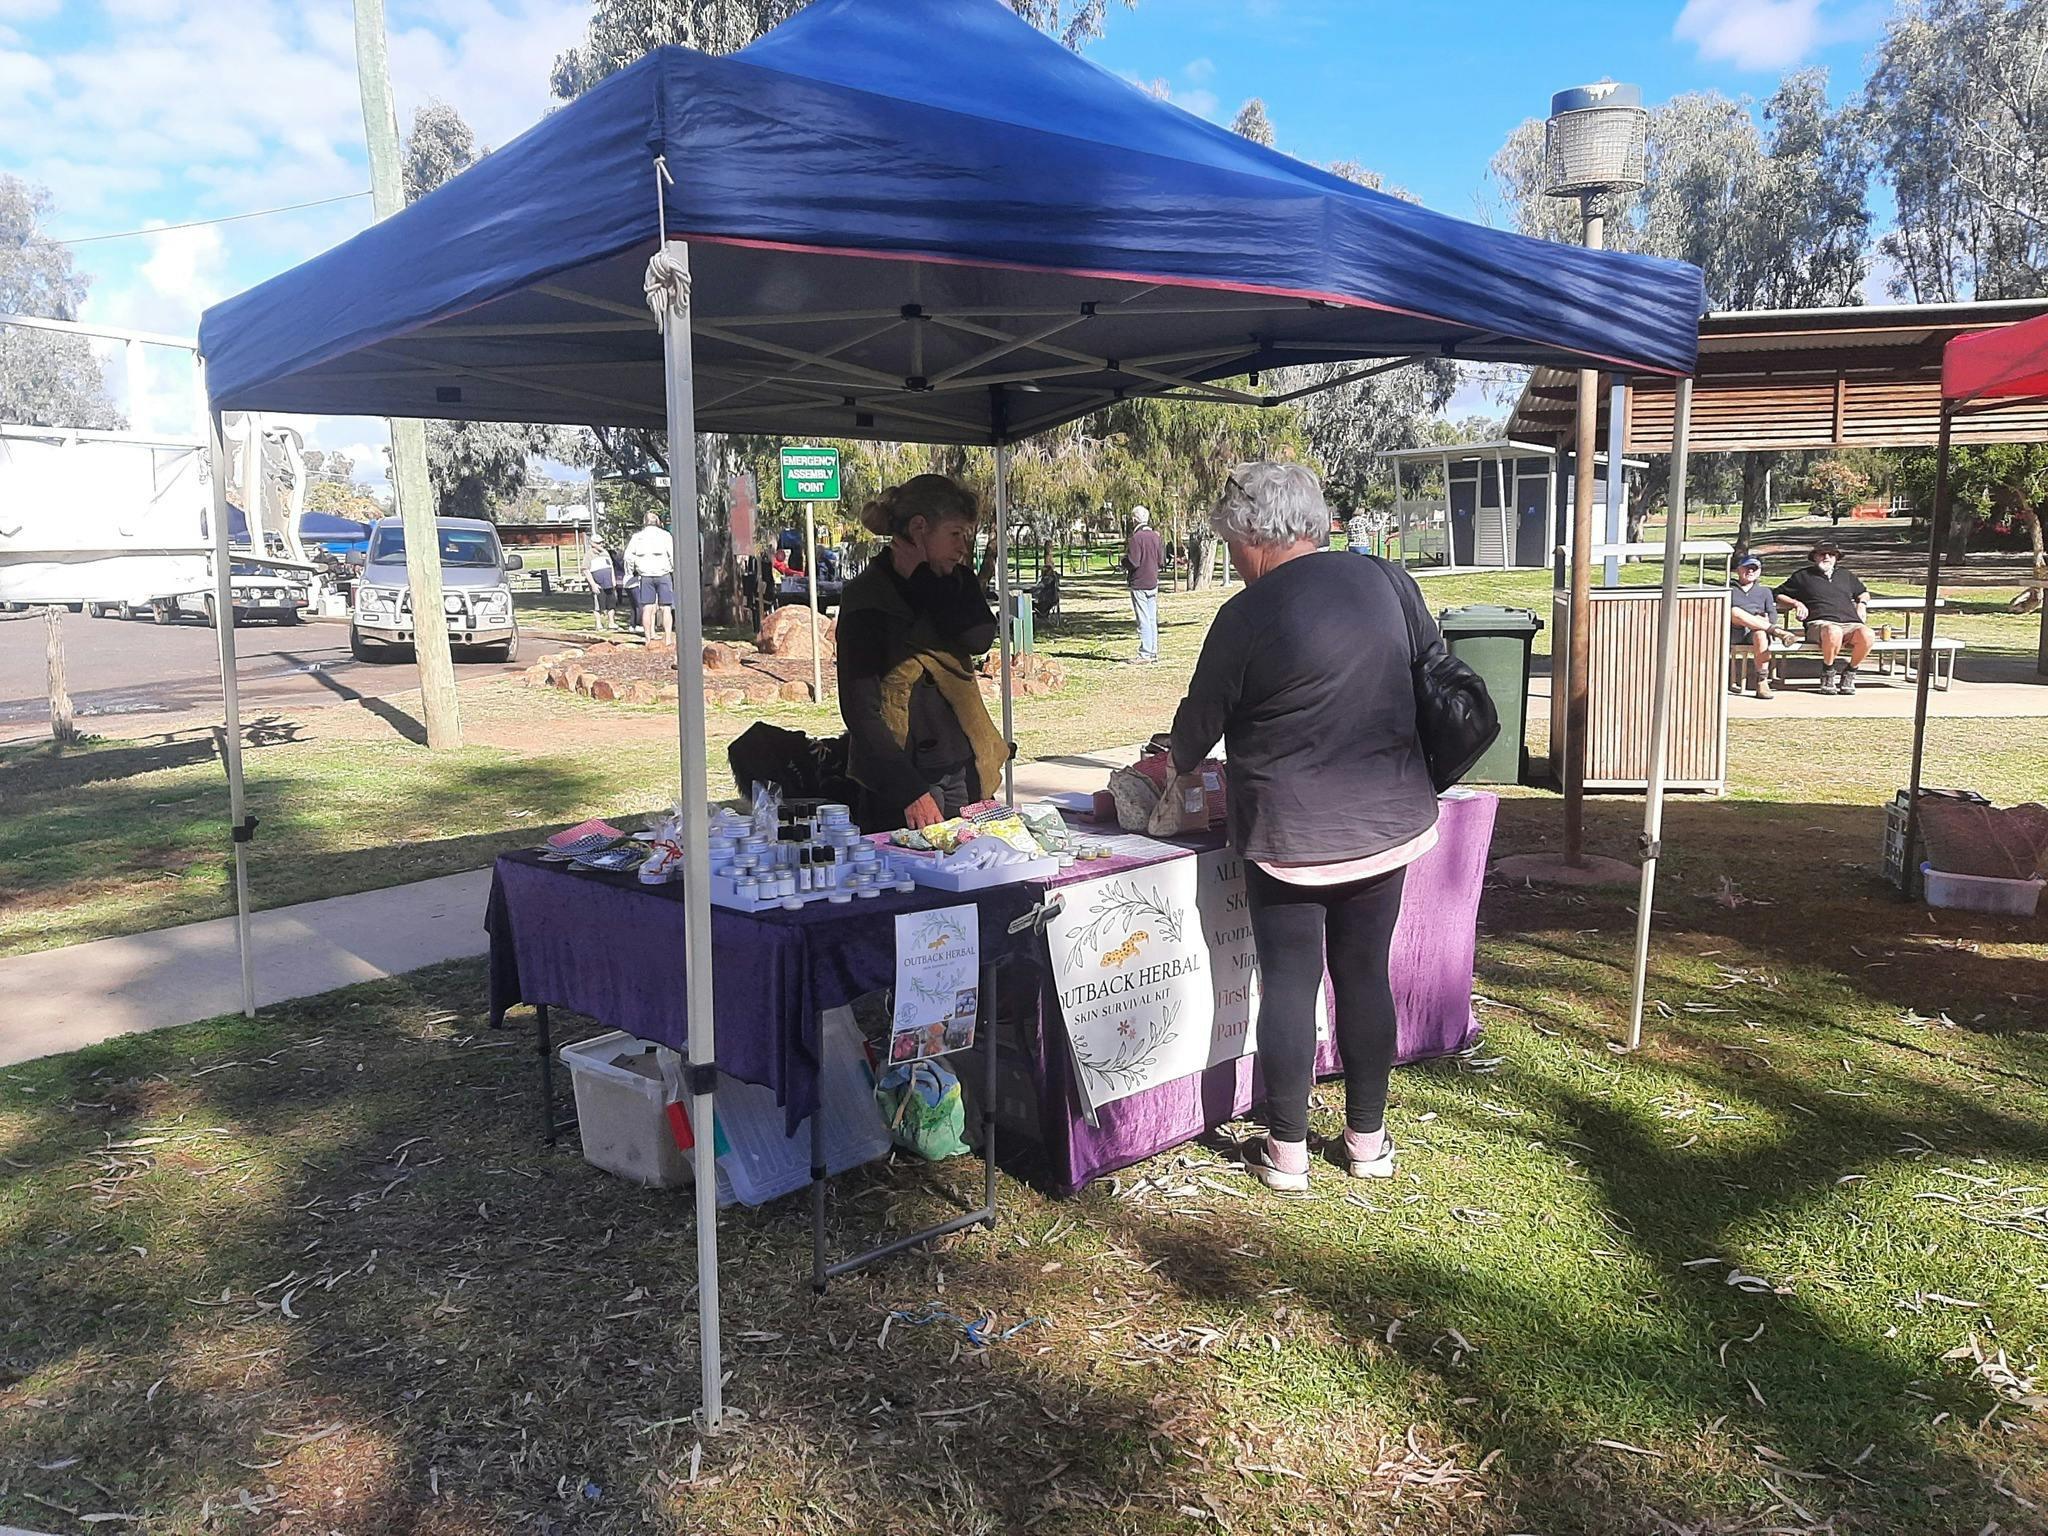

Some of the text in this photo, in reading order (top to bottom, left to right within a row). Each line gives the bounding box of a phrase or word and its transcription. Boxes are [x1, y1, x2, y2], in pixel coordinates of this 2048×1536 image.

[783, 455, 837, 466] EMERGENCY
[787, 469, 834, 479] ASSEMBLY
[797, 482, 825, 493] POINT
[1226, 889, 1248, 913] SKI
[903, 952, 944, 967] OUTBACK
[945, 947, 976, 960] HERBAL
[1138, 953, 1201, 988] HERBAL
[1074, 988, 1171, 1026] SKIN SURVIVAL KIT
[1216, 1020, 1249, 1042] Pam
